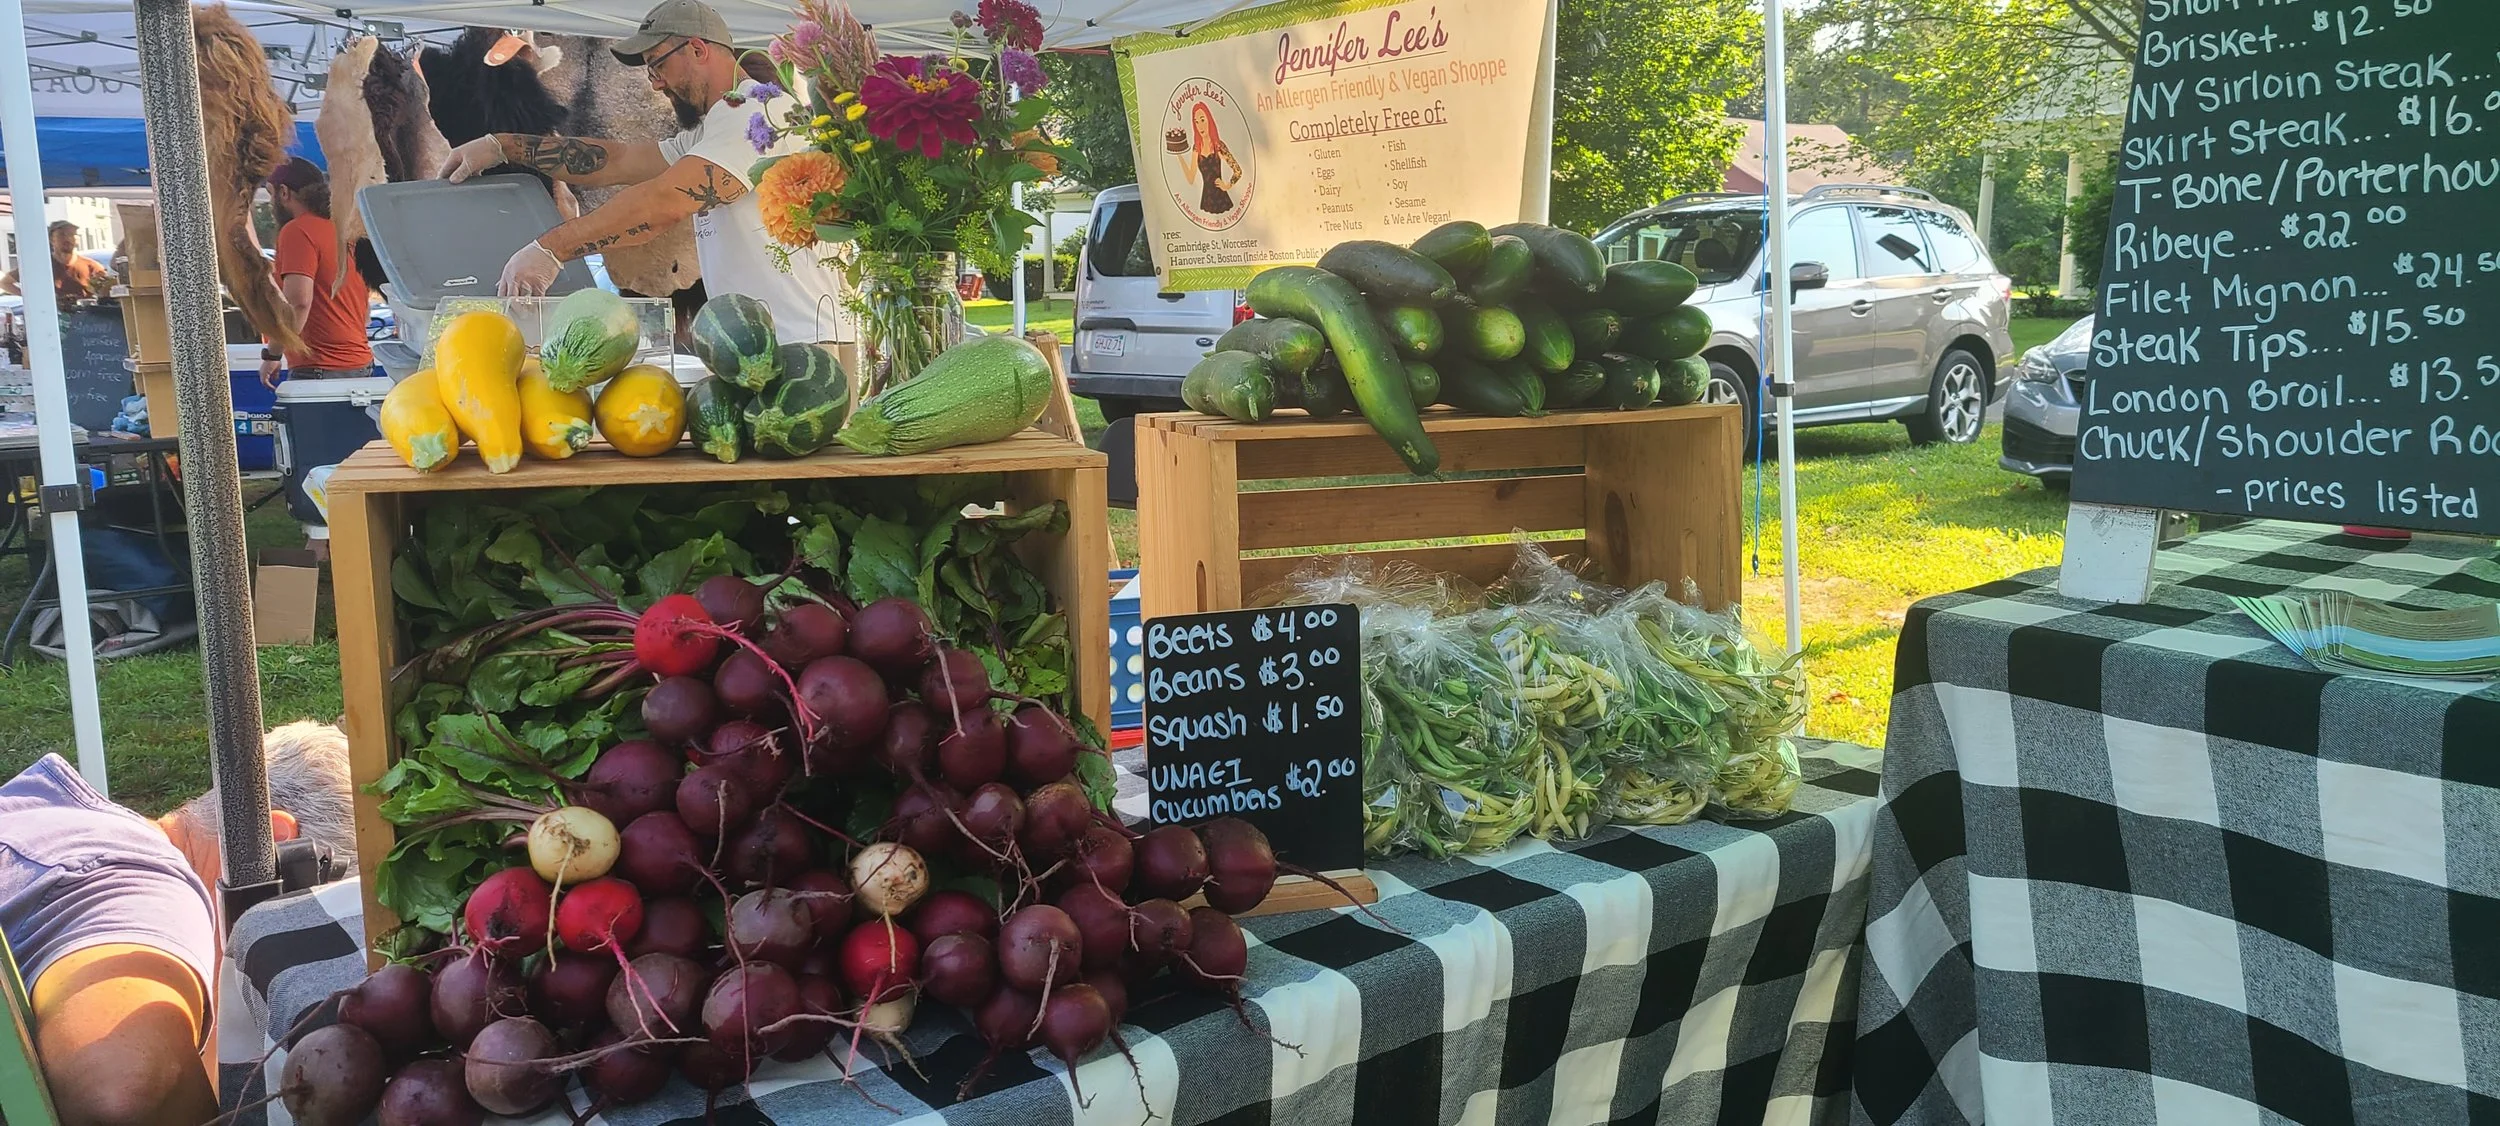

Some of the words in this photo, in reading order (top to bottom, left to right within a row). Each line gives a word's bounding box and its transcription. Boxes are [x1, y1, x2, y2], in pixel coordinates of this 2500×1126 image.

[1275, 21, 1369, 85] Jennifer
[1378, 6, 1449, 58] Lee's
[1170, 83, 1201, 121] Jennifer
[1203, 81, 1226, 107] Lee's
[1256, 92, 1274, 112] An
[1275, 87, 1329, 110] Allergen
[1331, 74, 1385, 101] Friendly
[1389, 71, 1401, 93] &
[1401, 68, 1447, 94] Vegan
[1449, 58, 1507, 86] Shoppe
[2132, 78, 2184, 124] NY
[2195, 70, 2321, 112] Sirloin
[1290, 110, 1379, 142] Completely
[1382, 108, 1420, 129] Free
[1424, 99, 1447, 124] of:
[1313, 149, 1342, 160] Gluten
[1387, 139, 1407, 152] Fish
[1389, 156, 1428, 171] Shellfish
[2125, 126, 2217, 171] Skirt
[1316, 168, 1336, 180] Eggs
[1319, 185, 1342, 197] Dairy
[1392, 179, 1408, 191] Soy
[1322, 203, 1354, 214] Peanuts
[1383, 215, 1390, 225] &
[1391, 214, 1405, 225] We
[1406, 213, 1421, 224] Are
[1421, 211, 1451, 226] Vegan!
[1394, 197, 1426, 209] Sesame
[1324, 220, 1342, 231] Tree
[1342, 219, 1363, 230] Nuts
[1166, 240, 1210, 253] Cambridge
[1221, 239, 1258, 249] Worcester
[1170, 255, 1206, 266] Hanover
[1217, 253, 1243, 264] Boston
[1243, 251, 1268, 263] (Inside
[1269, 250, 1295, 261] Boston
[1295, 248, 1320, 260] Public
[2106, 279, 2192, 317] Filet
[2392, 251, 2500, 289] $24.5
[2091, 326, 2201, 368] Steak
[2088, 378, 2229, 416] London
[2244, 477, 2346, 512] prices
[2377, 479, 2479, 519] listed
[1148, 622, 1234, 660] Beets
[1251, 609, 1338, 643] $4.00
[1149, 662, 1246, 704] Beans
[1259, 647, 1341, 690] $3.00
[1149, 705, 1247, 752] Squash
[1262, 695, 1344, 734] $1.50
[1285, 757, 1356, 798] $2.00
